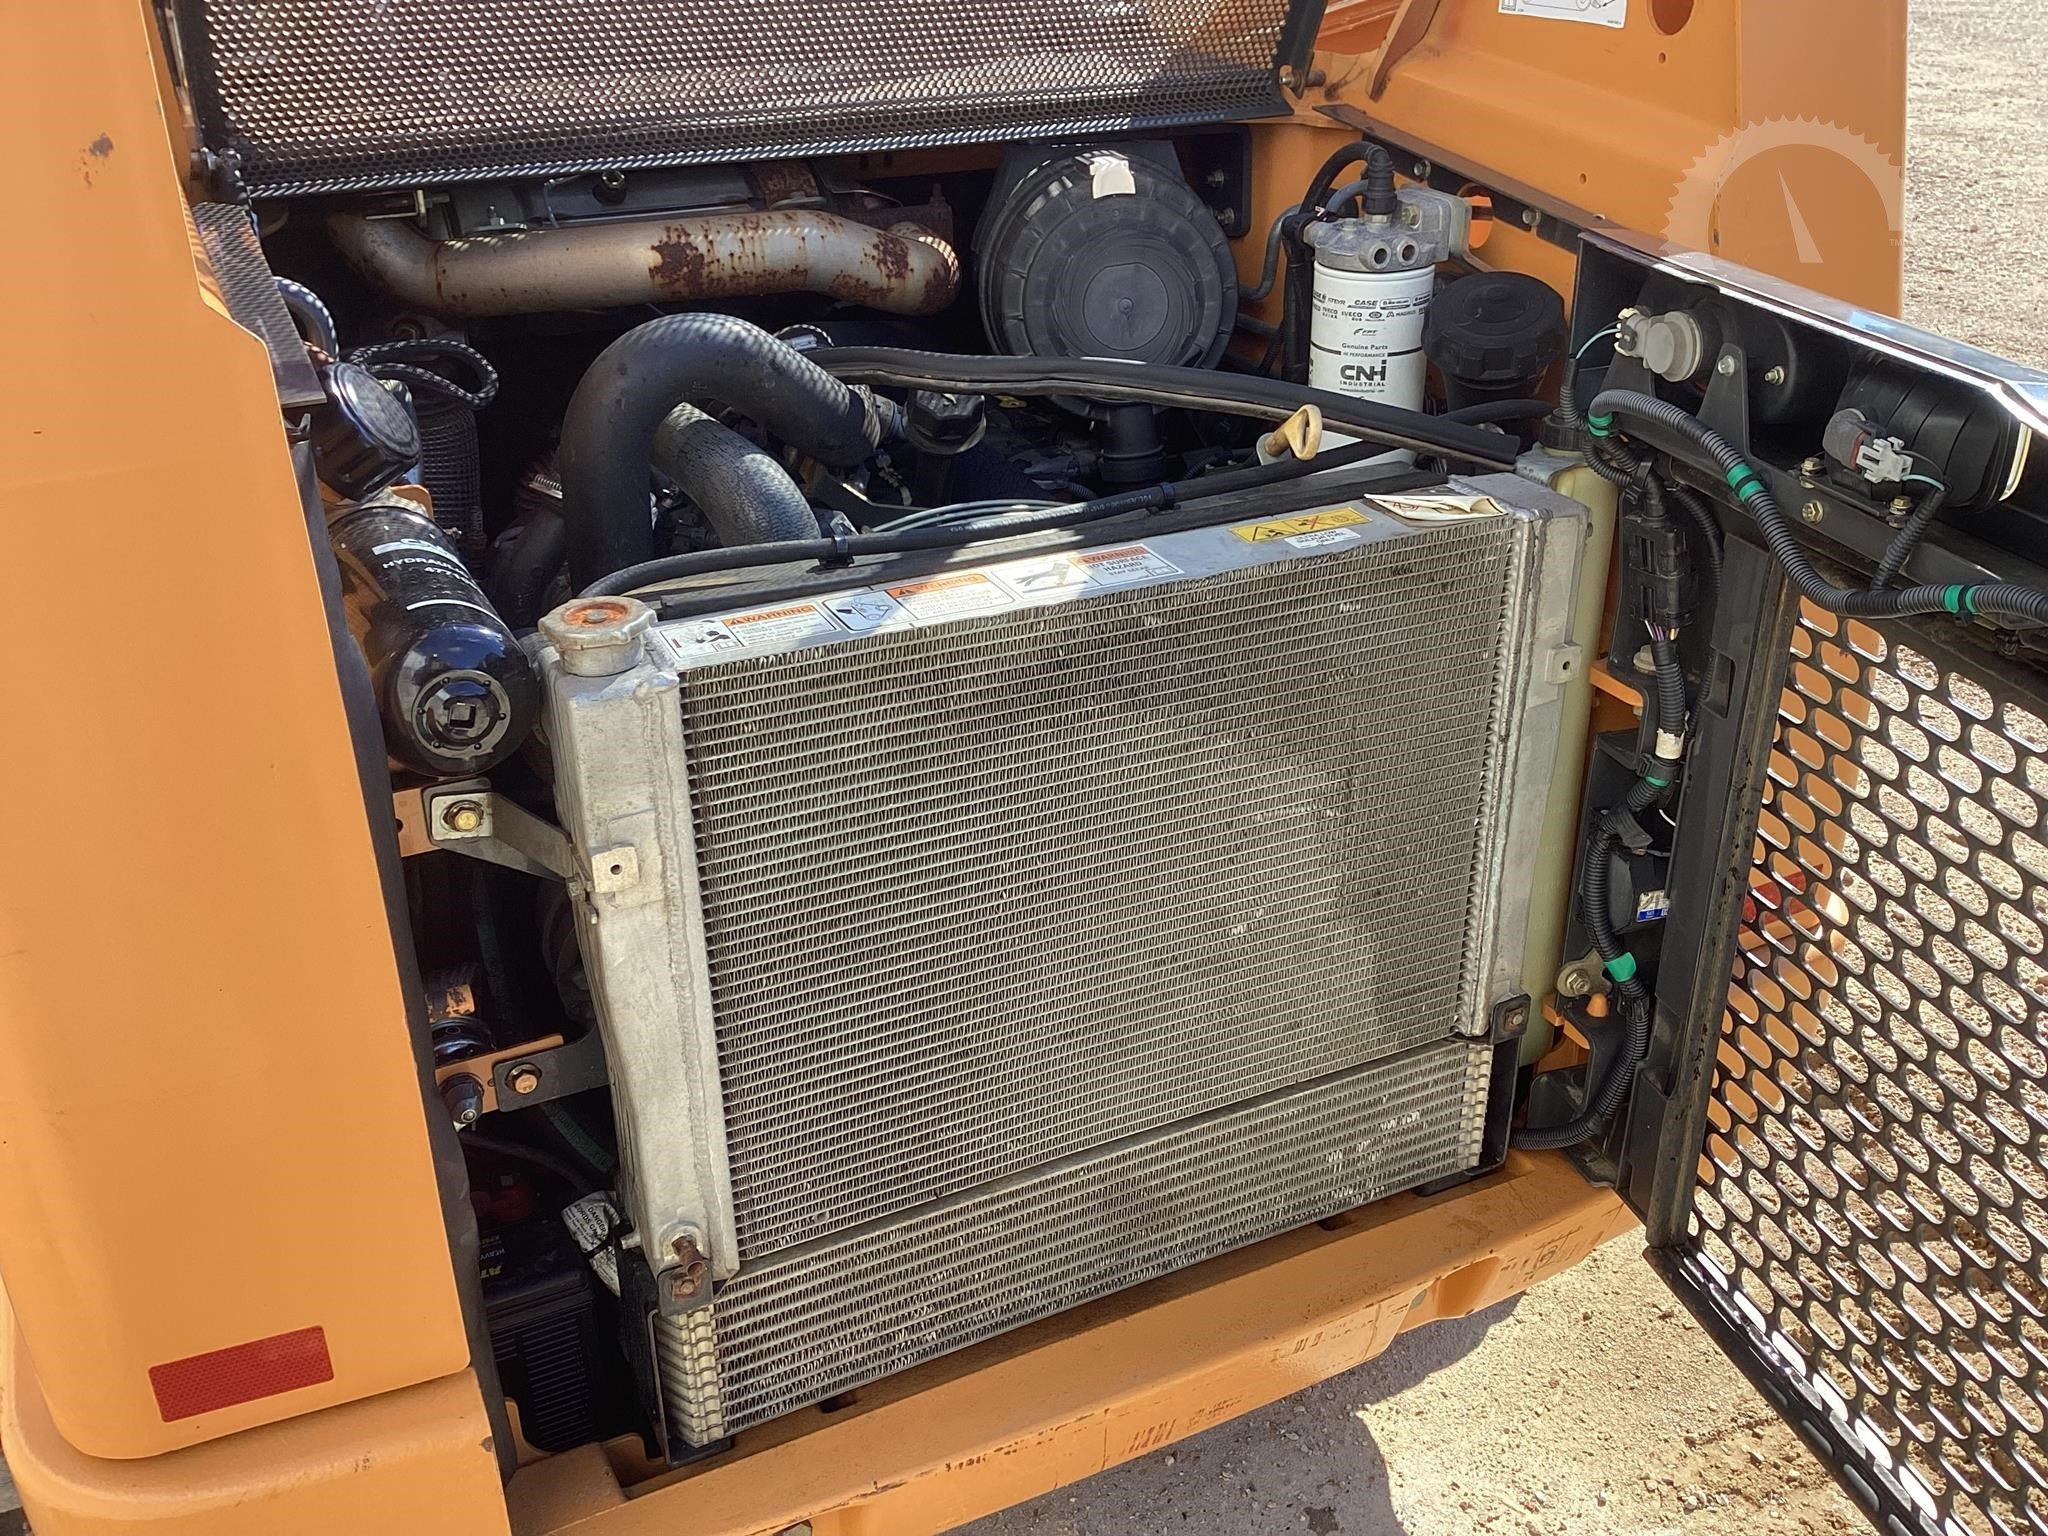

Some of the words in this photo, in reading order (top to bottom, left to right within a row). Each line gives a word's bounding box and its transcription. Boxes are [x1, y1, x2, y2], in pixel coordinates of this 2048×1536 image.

[1087, 548, 1147, 562] WARNING
[1106, 555, 1149, 566] SURFACE
[1103, 561, 1143, 572] HAZARD
[917, 575, 980, 591] WARNING
[743, 605, 813, 623] WARNING
[587, 1207, 607, 1232] DANGER
